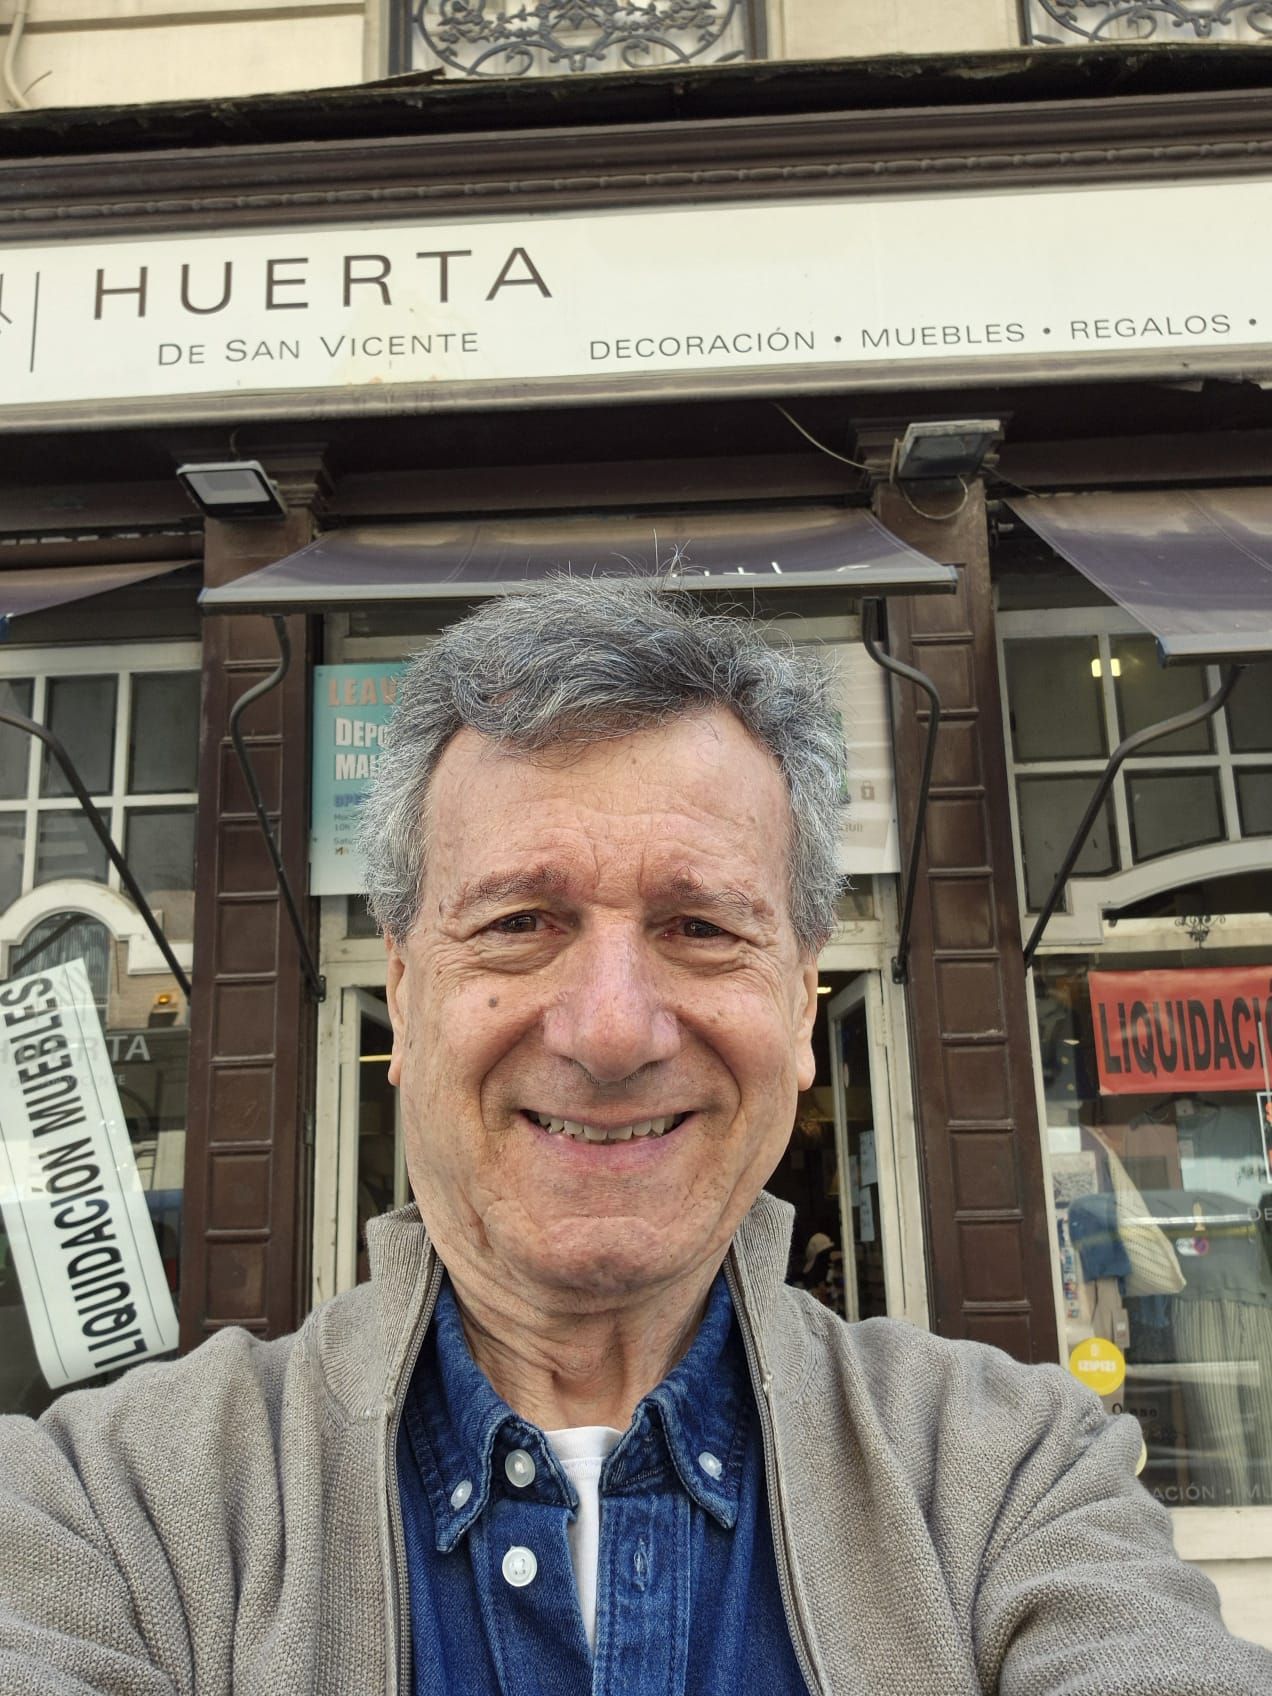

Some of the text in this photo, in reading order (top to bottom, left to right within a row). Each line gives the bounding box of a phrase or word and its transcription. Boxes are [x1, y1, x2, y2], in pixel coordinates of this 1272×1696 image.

[94, 247, 553, 320] HUERTA
[158, 332, 478, 366] DE SAN VICENTE
[590, 314, 1231, 360] DECORACIÓN MUEBLES REGALOS
[0, 977, 88, 1138] MUEBLES
[32, 1136, 149, 1369] LIQUIDACIÓN
